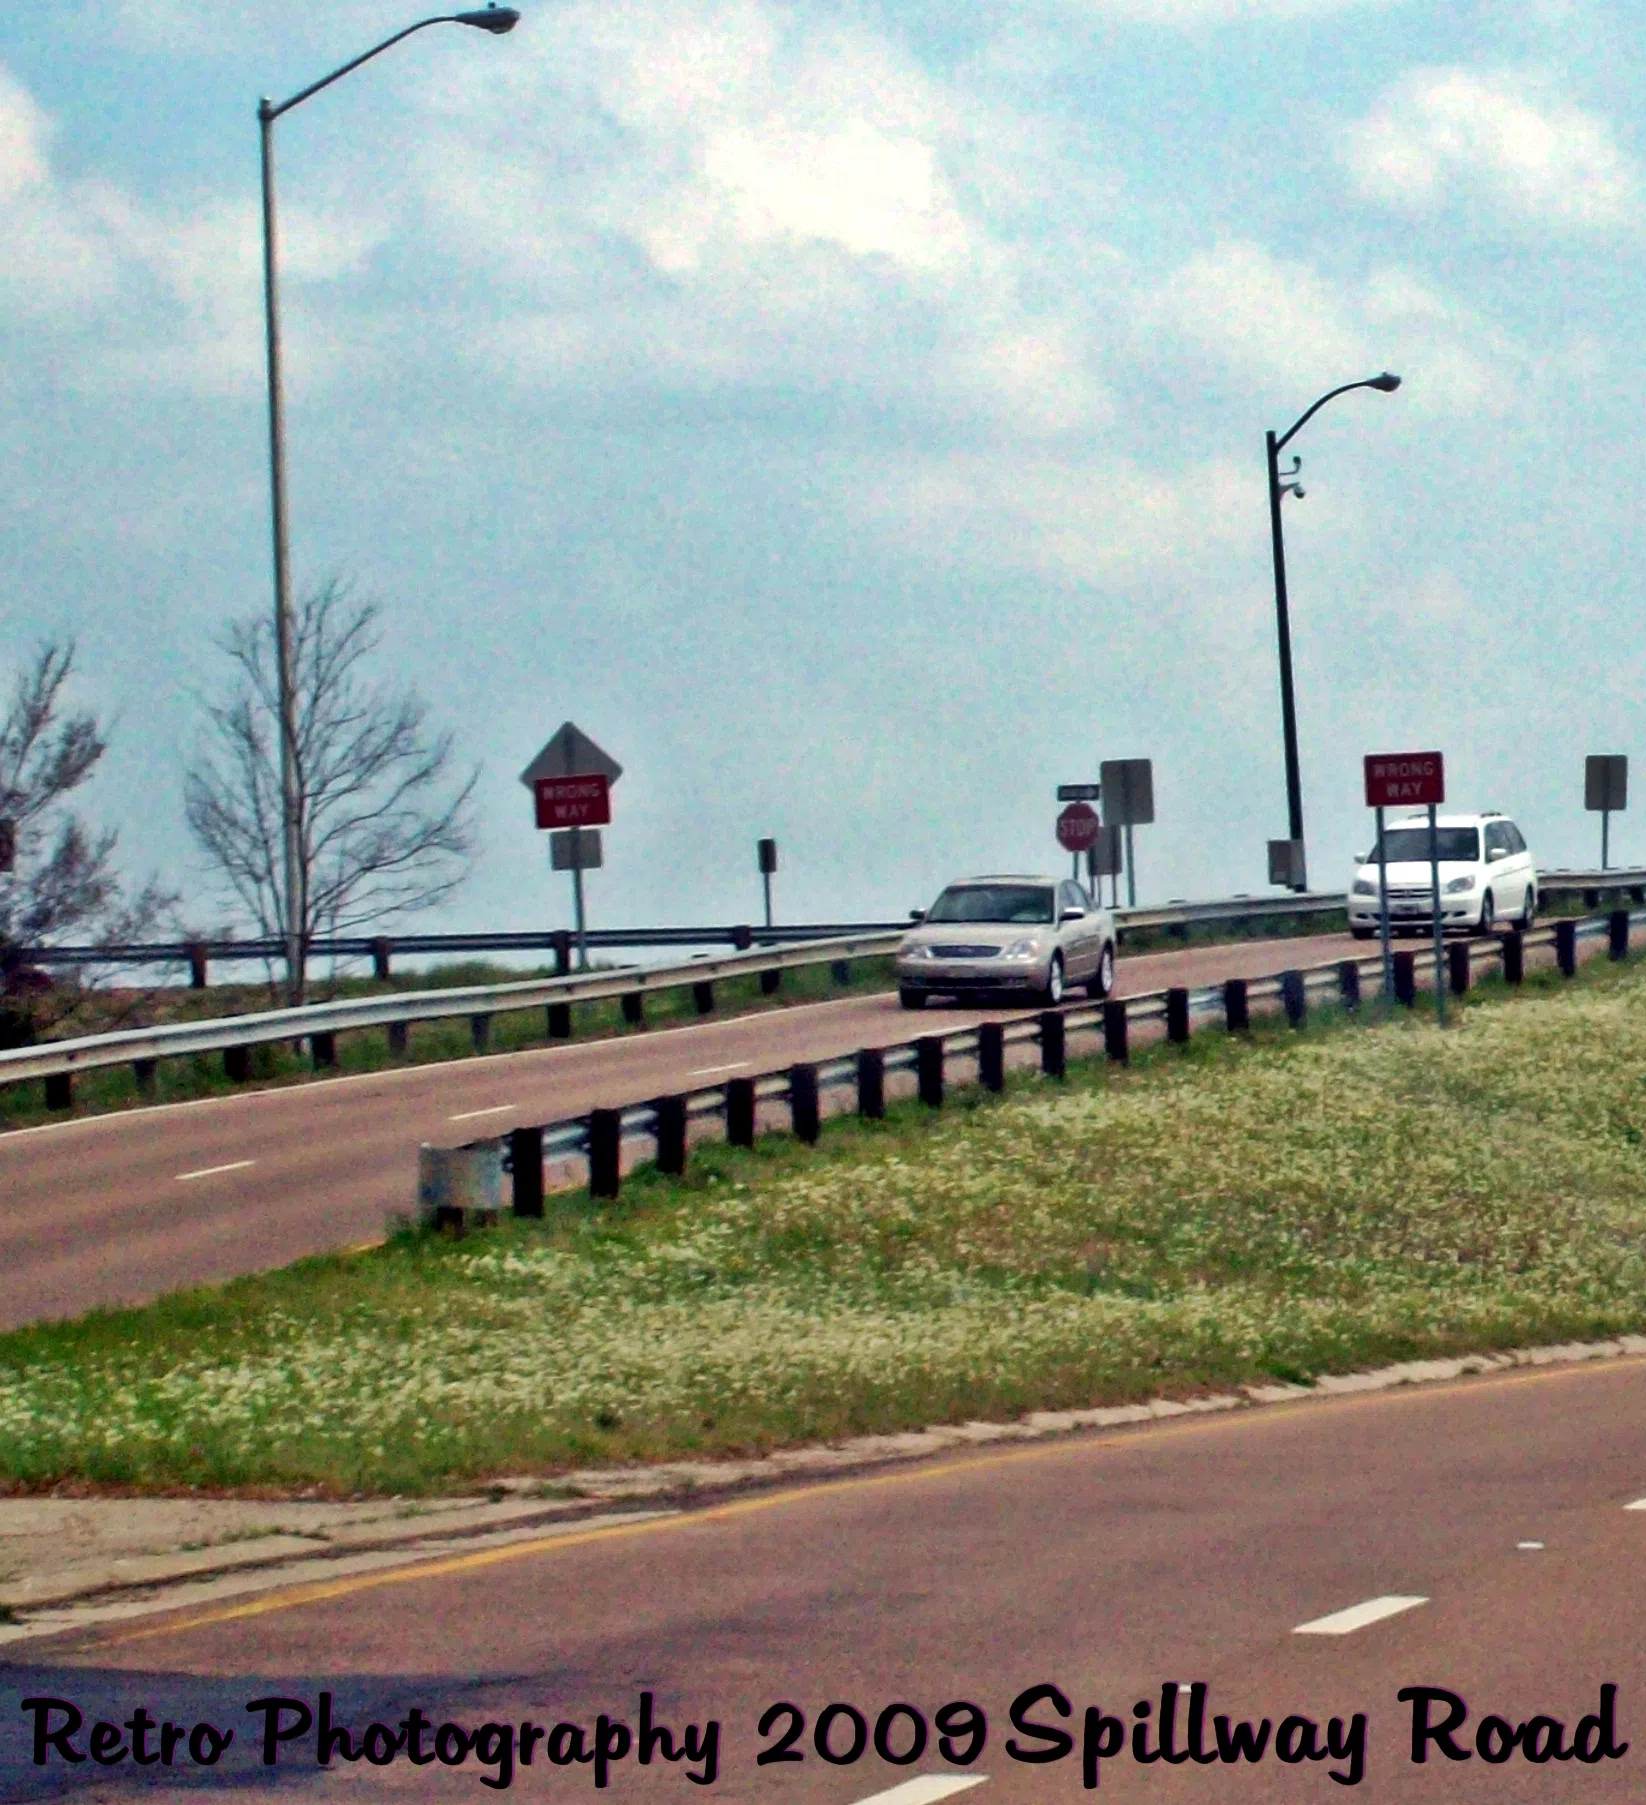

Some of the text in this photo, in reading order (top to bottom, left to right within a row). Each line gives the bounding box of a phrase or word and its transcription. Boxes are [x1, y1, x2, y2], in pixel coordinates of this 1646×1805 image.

[1373, 761, 1434, 777] WRONG
[542, 783, 600, 800] WRONG
[1387, 782, 1422, 797] WAY
[555, 804, 589, 819] WAY
[1061, 818, 1097, 836] STOP
